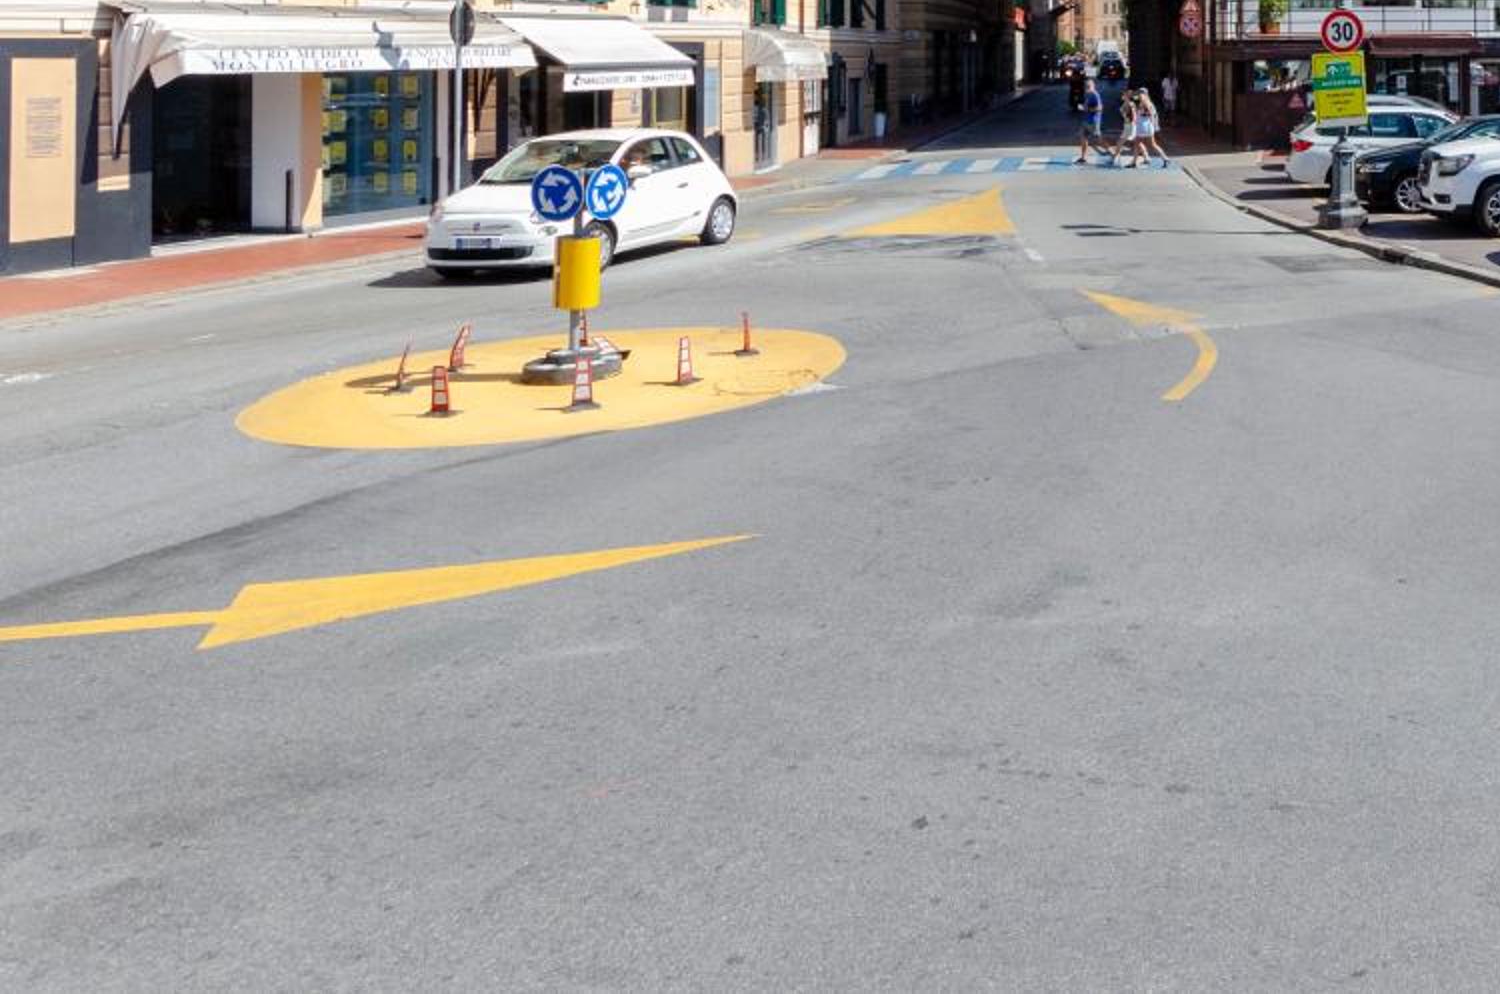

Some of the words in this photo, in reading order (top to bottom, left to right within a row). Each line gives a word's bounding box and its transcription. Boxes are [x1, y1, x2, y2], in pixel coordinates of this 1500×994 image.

[1331, 22, 1353, 42] 30
[219, 47, 289, 59] CENTRO
[297, 47, 359, 59] MEDICO
[212, 59, 363, 71] MONTALLEGRO
